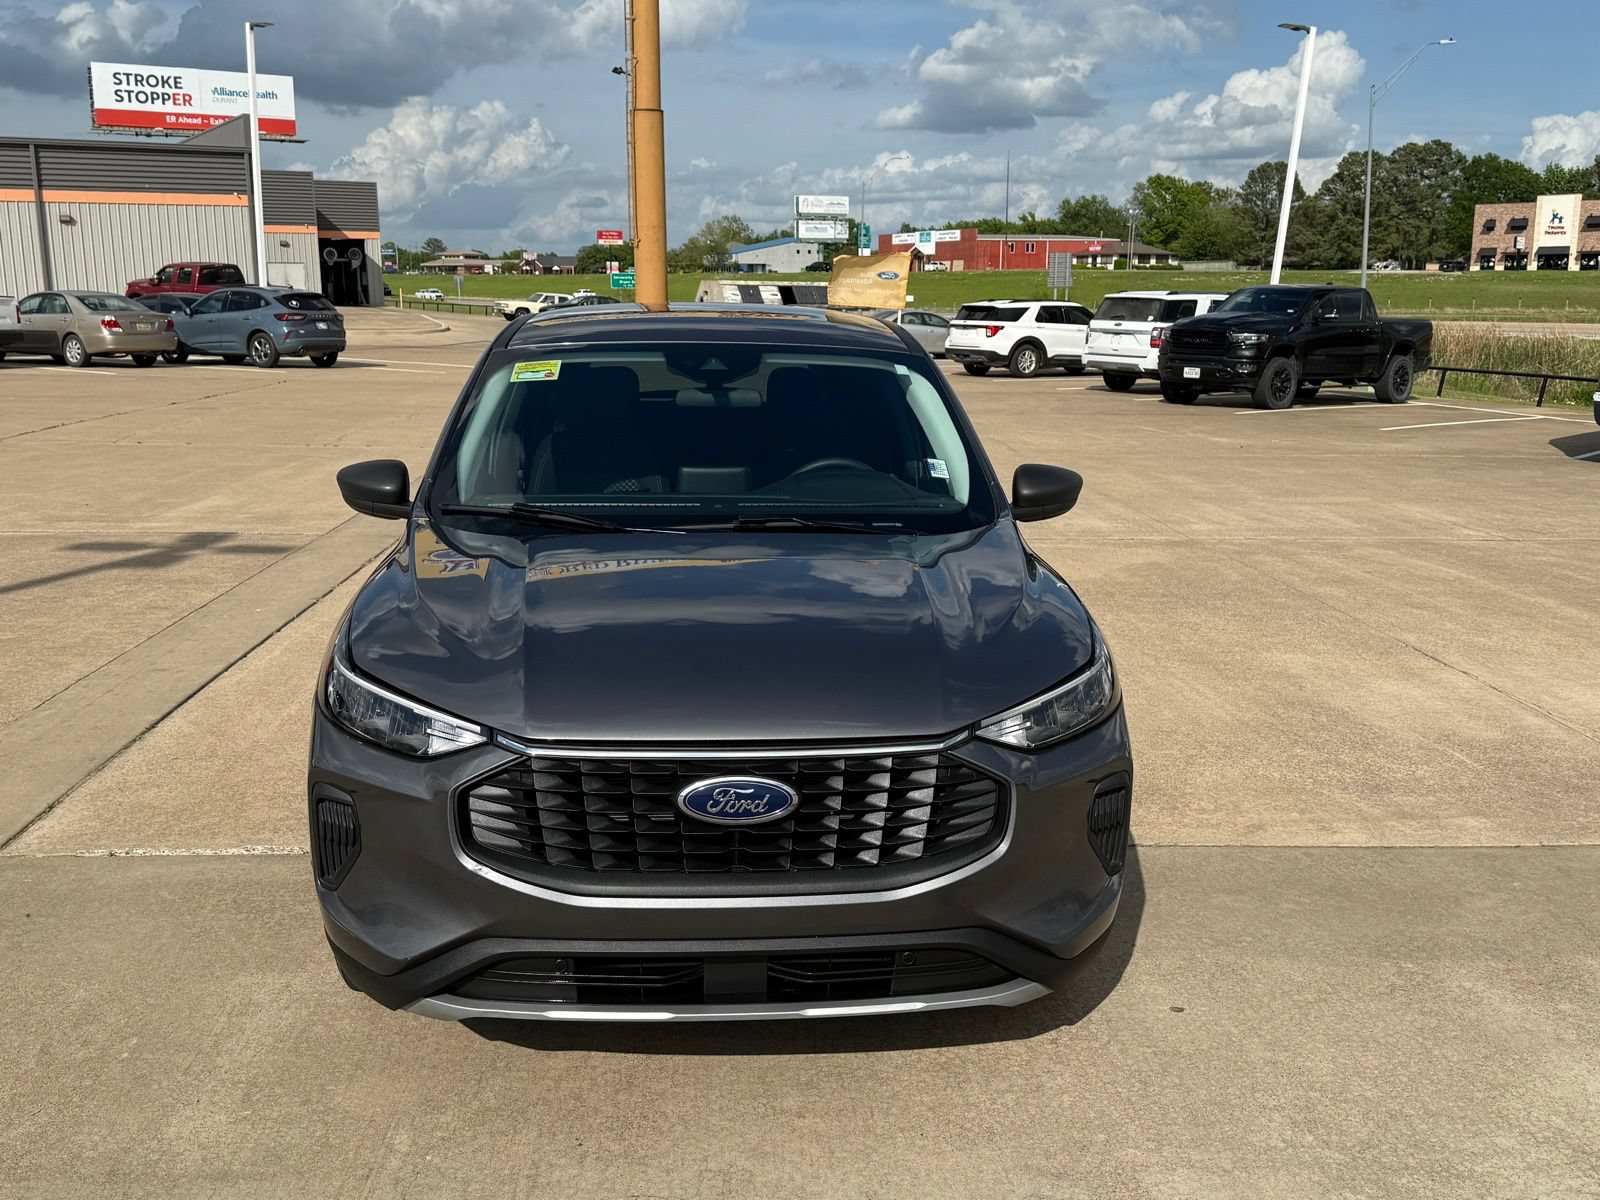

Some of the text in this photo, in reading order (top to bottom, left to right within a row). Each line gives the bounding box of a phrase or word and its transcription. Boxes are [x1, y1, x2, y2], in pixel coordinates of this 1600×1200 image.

[112, 72, 184, 90] STROKE
[113, 89, 193, 107] STOPPER
[211, 86, 278, 100] Allianceealth
[165, 115, 176, 123] ER
[178, 116, 202, 124] Ahead
[706, 787, 771, 814] Ford
